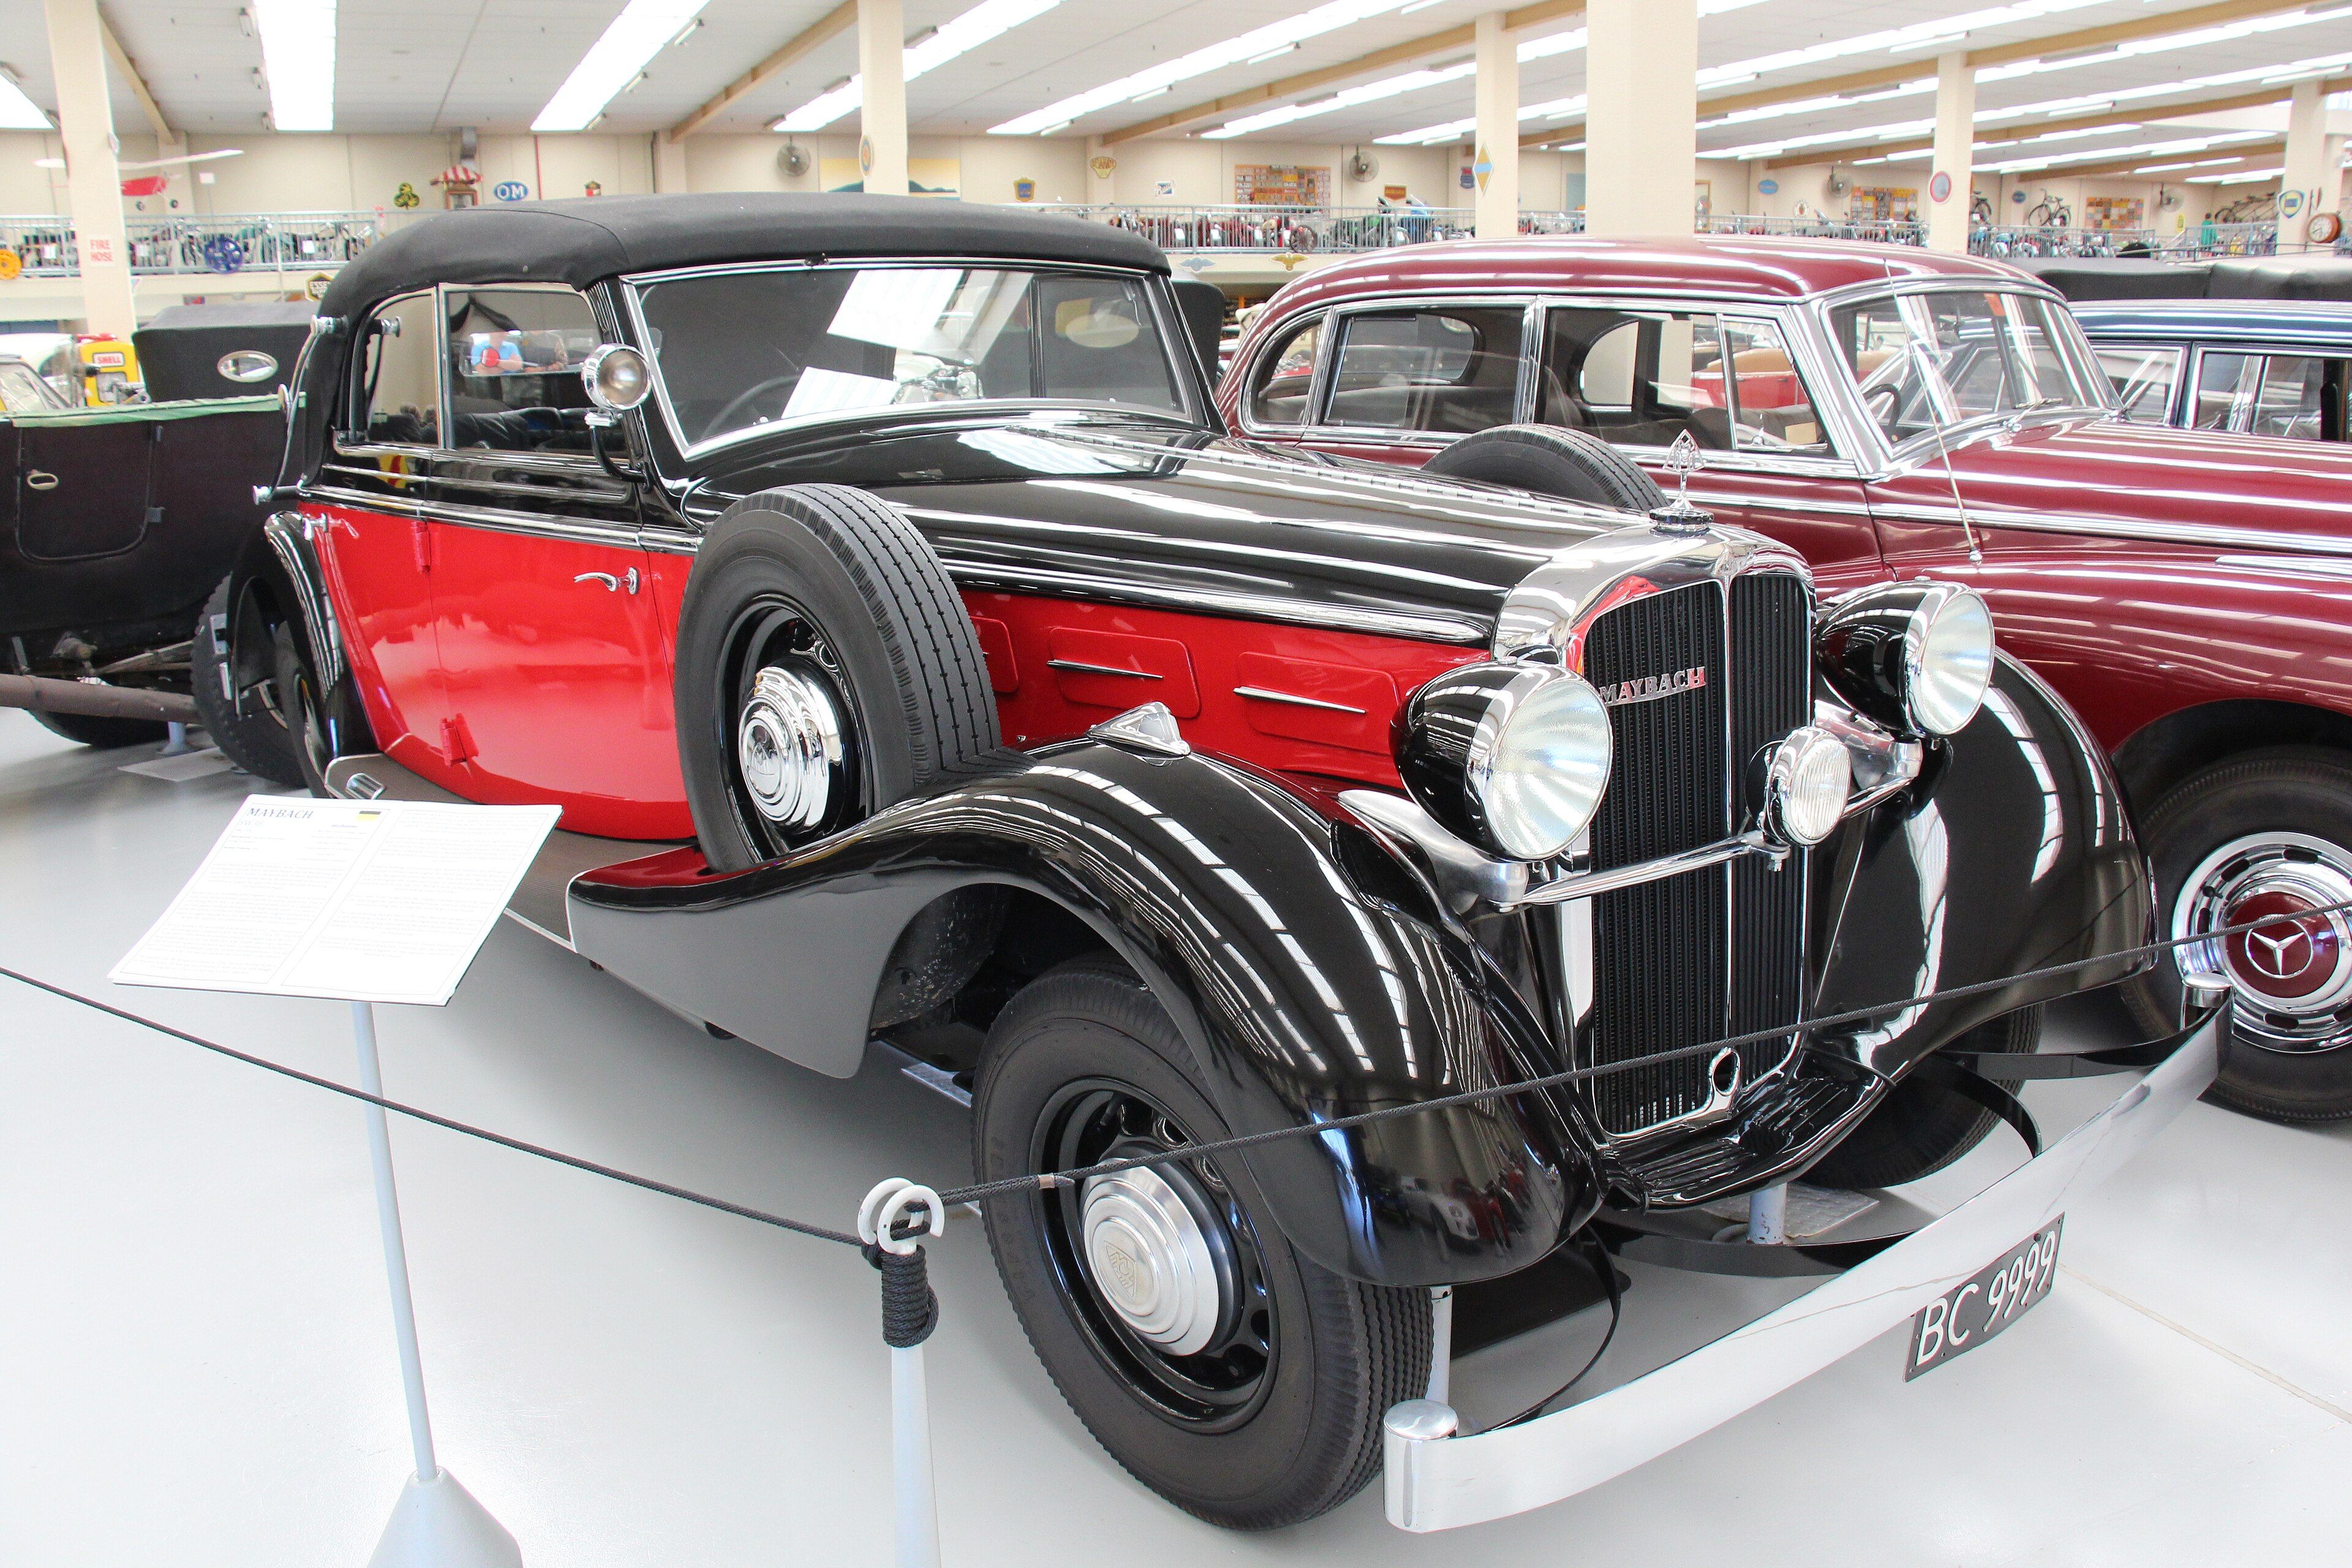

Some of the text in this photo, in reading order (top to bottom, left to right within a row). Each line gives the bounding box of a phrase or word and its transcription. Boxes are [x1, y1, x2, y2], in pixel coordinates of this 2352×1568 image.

[497, 184, 525, 199] OM
[90, 239, 111, 249] FIRE
[90, 252, 113, 262] HOSE
[1598, 666, 1707, 704] MAYBACH
[247, 808, 314, 819] MAYBACH
[1915, 1230, 2056, 1366] BC 9999
